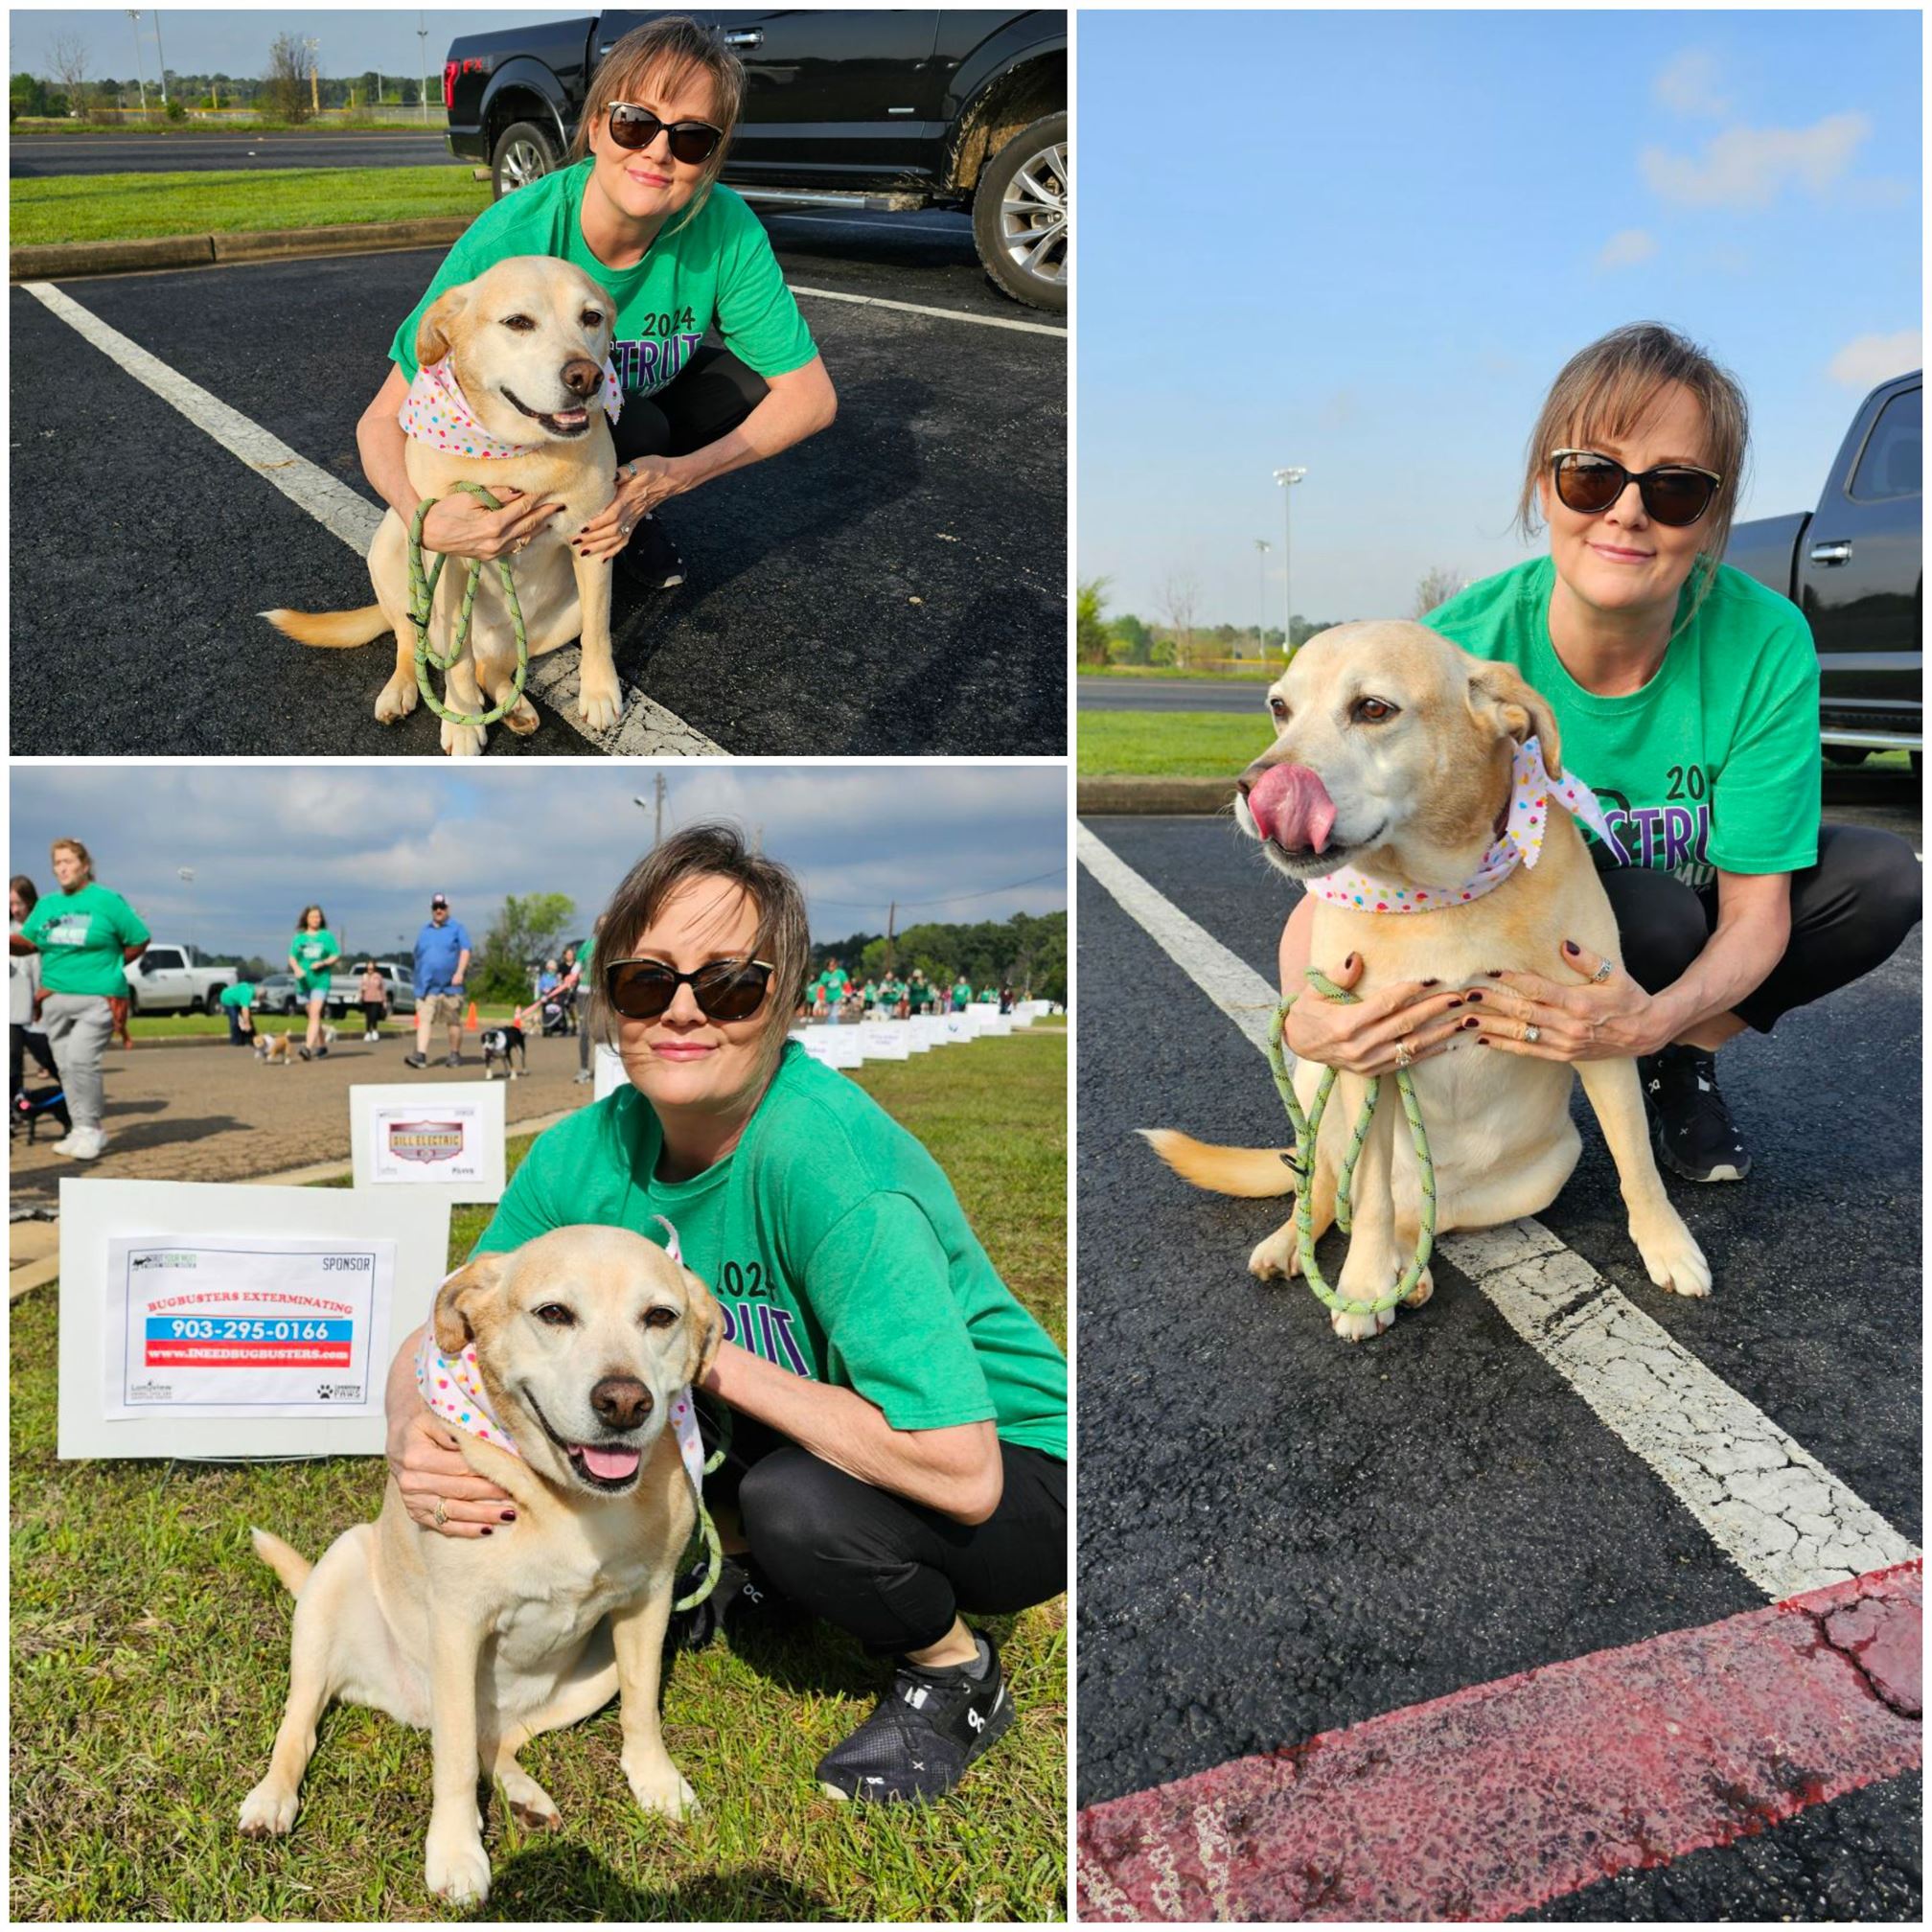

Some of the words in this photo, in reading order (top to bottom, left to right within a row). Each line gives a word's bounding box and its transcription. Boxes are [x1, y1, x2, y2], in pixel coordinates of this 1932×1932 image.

[641, 306, 696, 337] 2024
[610, 333, 702, 390] TRUT
[416, 1135, 459, 1146] ELECTRIC
[323, 1257, 370, 1271] SPONSOR
[148, 1292, 239, 1312] BUGBUSTERS
[242, 1292, 353, 1315] EXTERMINATING
[172, 1320, 329, 1340] 903-295-0166
[148, 1347, 349, 1360] www.INEEDBUGBUSTERS.com
